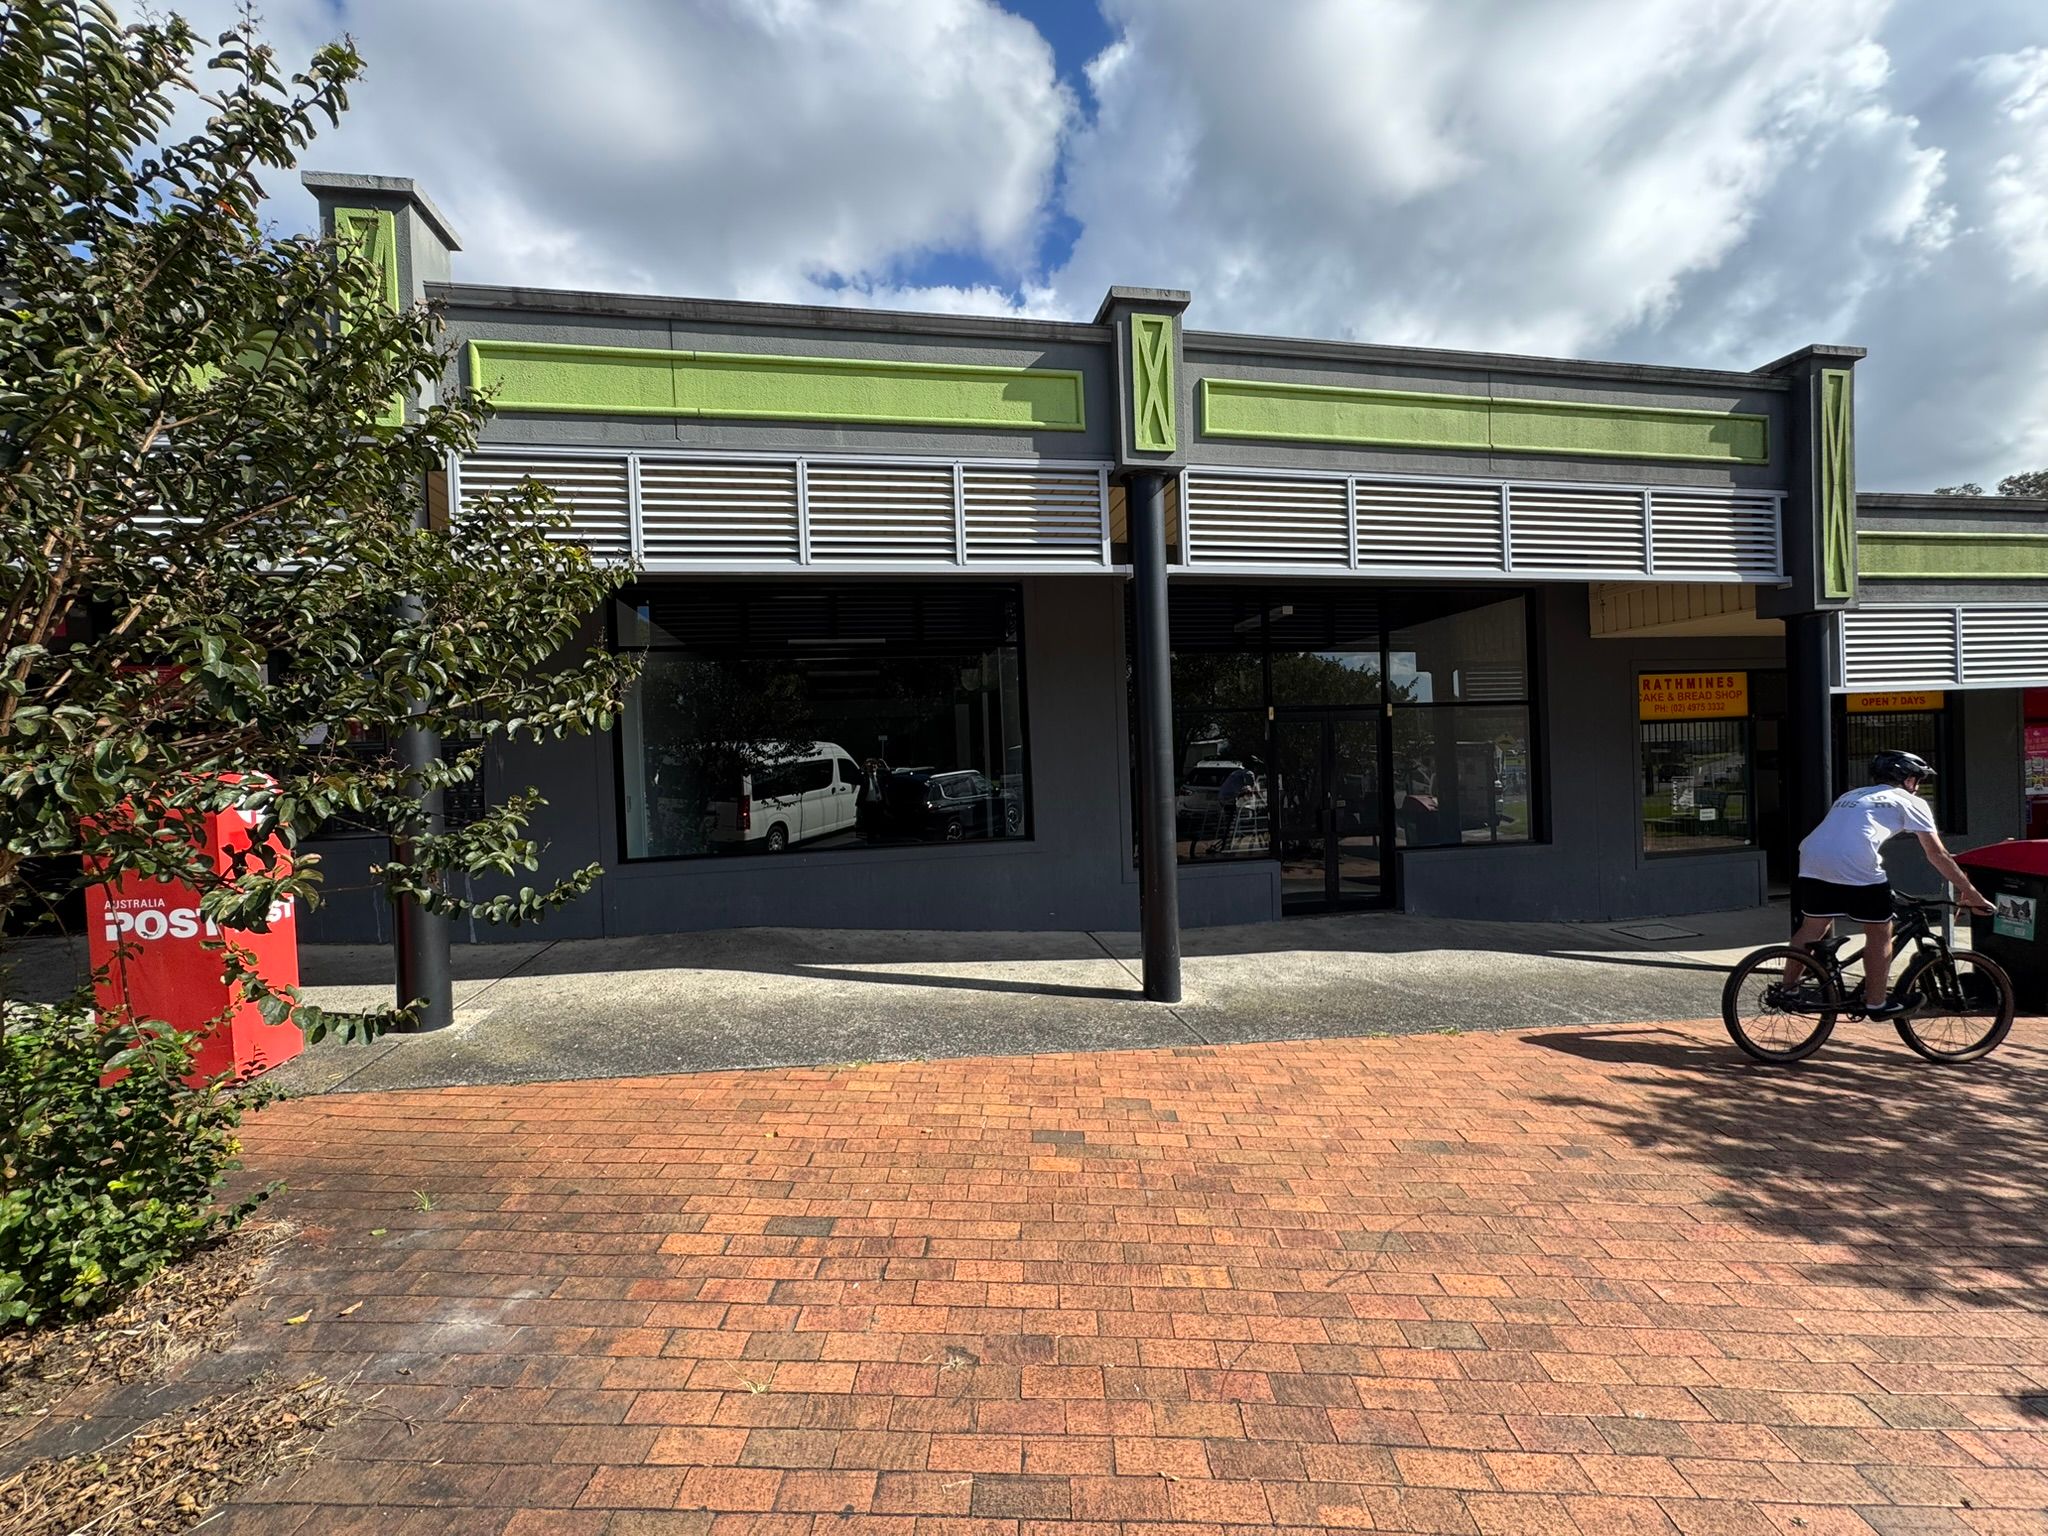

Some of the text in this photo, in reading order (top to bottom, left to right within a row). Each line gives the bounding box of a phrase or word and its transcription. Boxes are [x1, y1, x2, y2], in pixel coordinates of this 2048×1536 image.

[1642, 677, 1734, 690] RATHMINES
[1639, 690, 1742, 702] AKE & BREAD SHOP
[1861, 696, 1926, 706] OPEN 7 DAYS
[1671, 703, 1685, 714] (02)
[104, 898, 165, 910] AUSTRALIA
